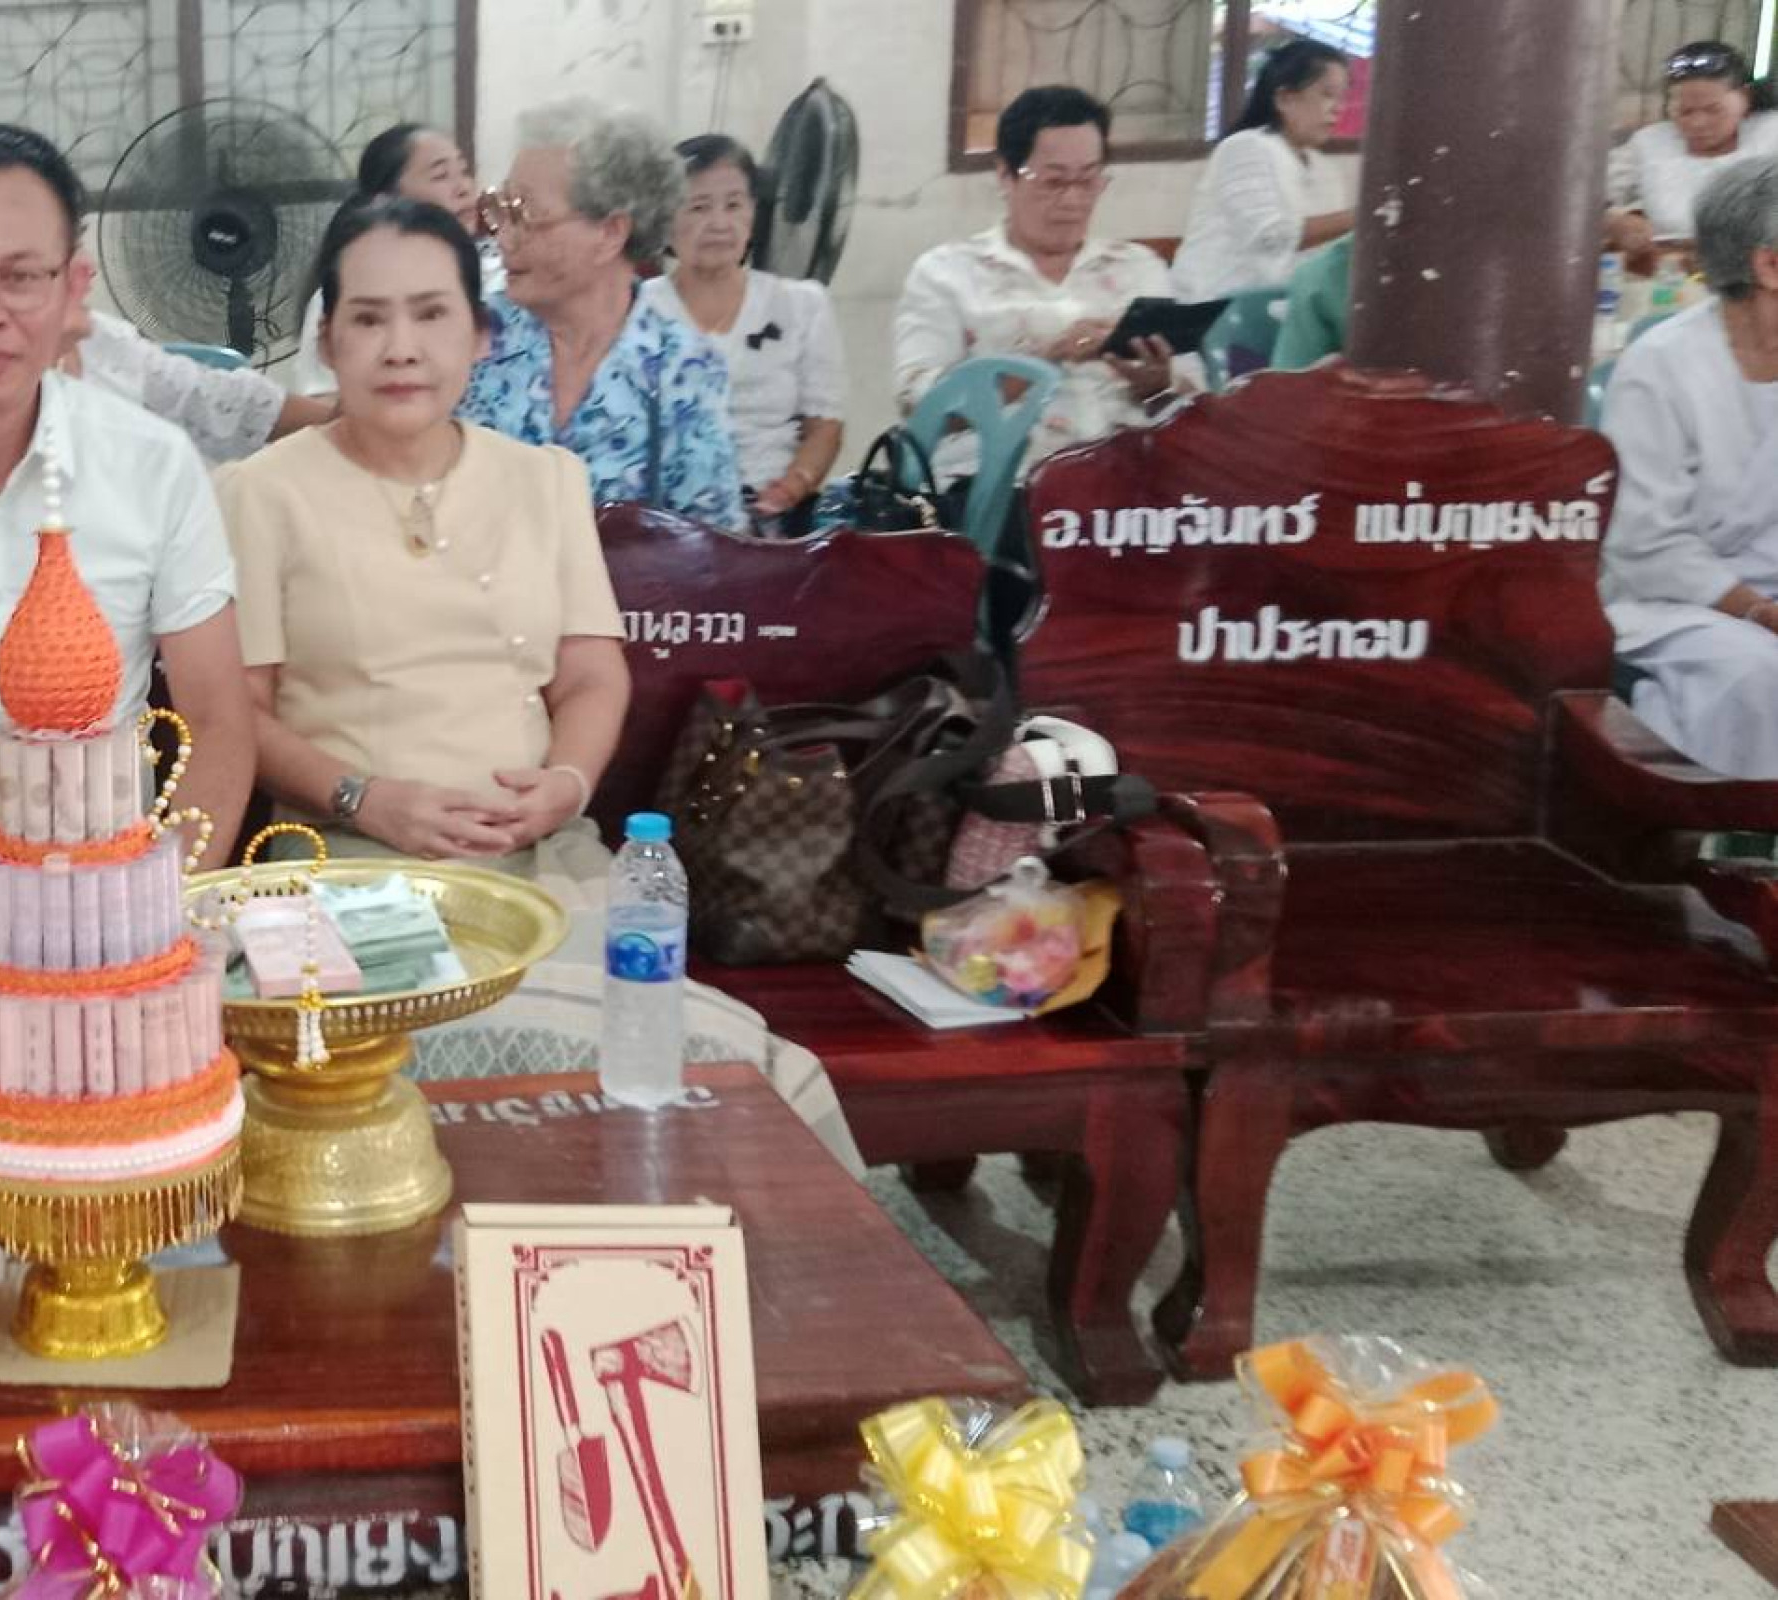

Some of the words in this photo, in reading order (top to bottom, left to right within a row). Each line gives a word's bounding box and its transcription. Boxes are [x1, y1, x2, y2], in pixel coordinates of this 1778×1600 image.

[1040, 494, 1321, 558] อ.บุญจันทร์
[1177, 605, 1429, 662] ปาประกอบ
